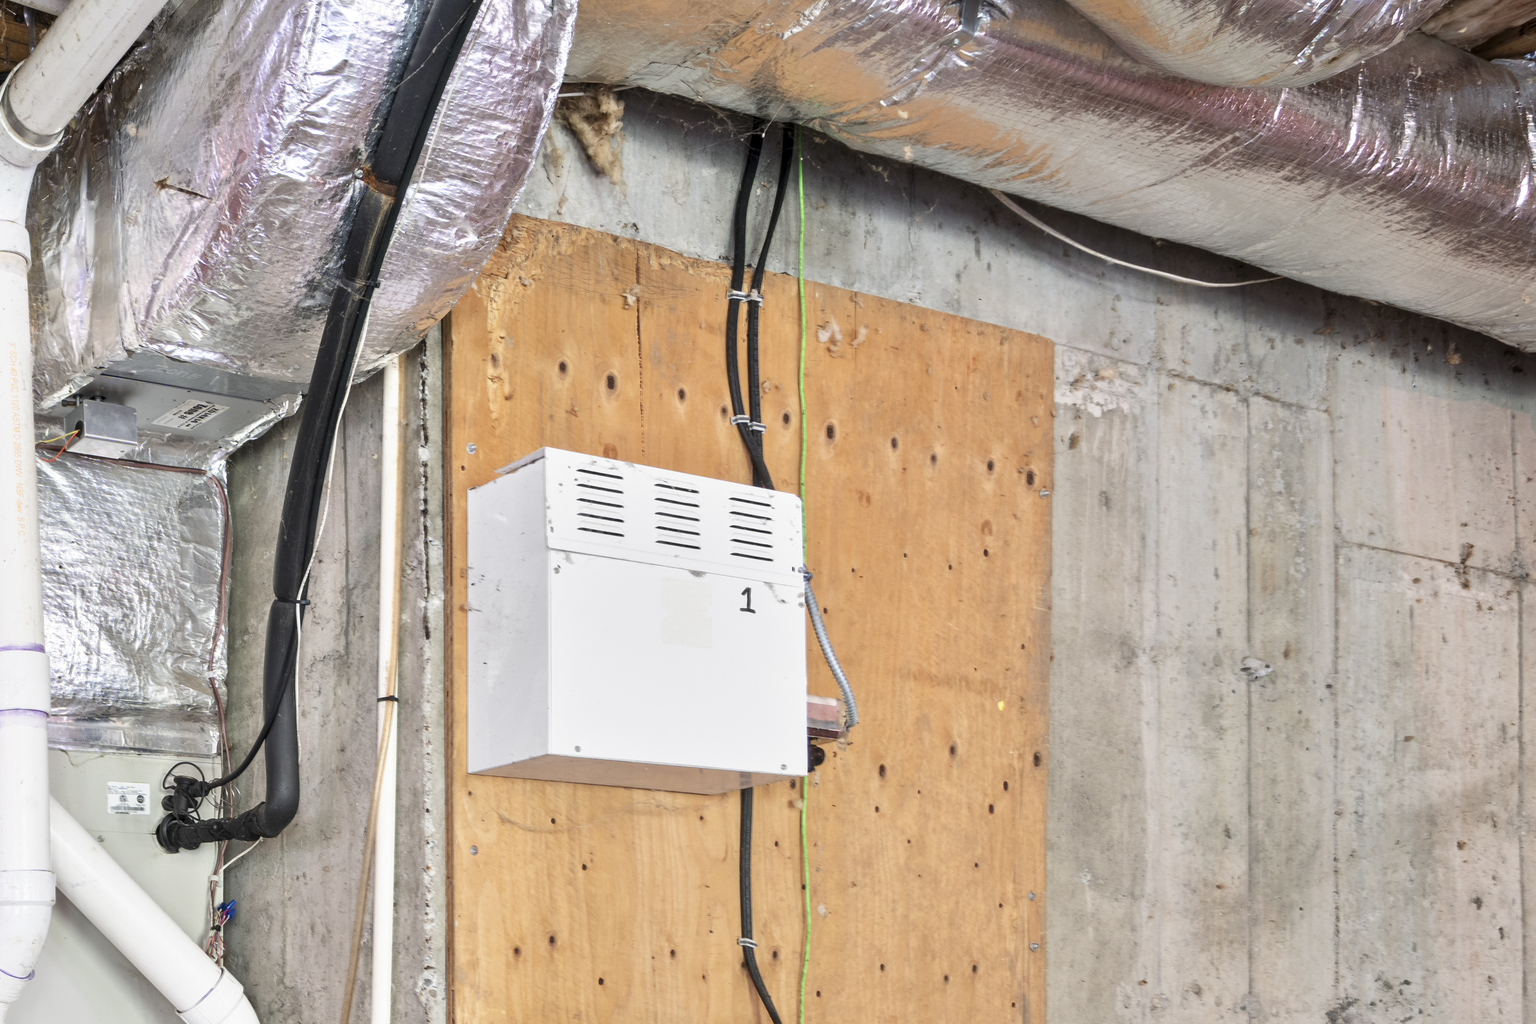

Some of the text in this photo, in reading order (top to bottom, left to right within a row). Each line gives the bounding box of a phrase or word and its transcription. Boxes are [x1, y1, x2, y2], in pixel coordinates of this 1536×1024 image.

[11, 368, 18, 376] 40
[11, 378, 19, 393] PVC
[12, 395, 20, 411] 1120
[13, 412, 21, 433] ASTM
[740, 586, 756, 614] 1
